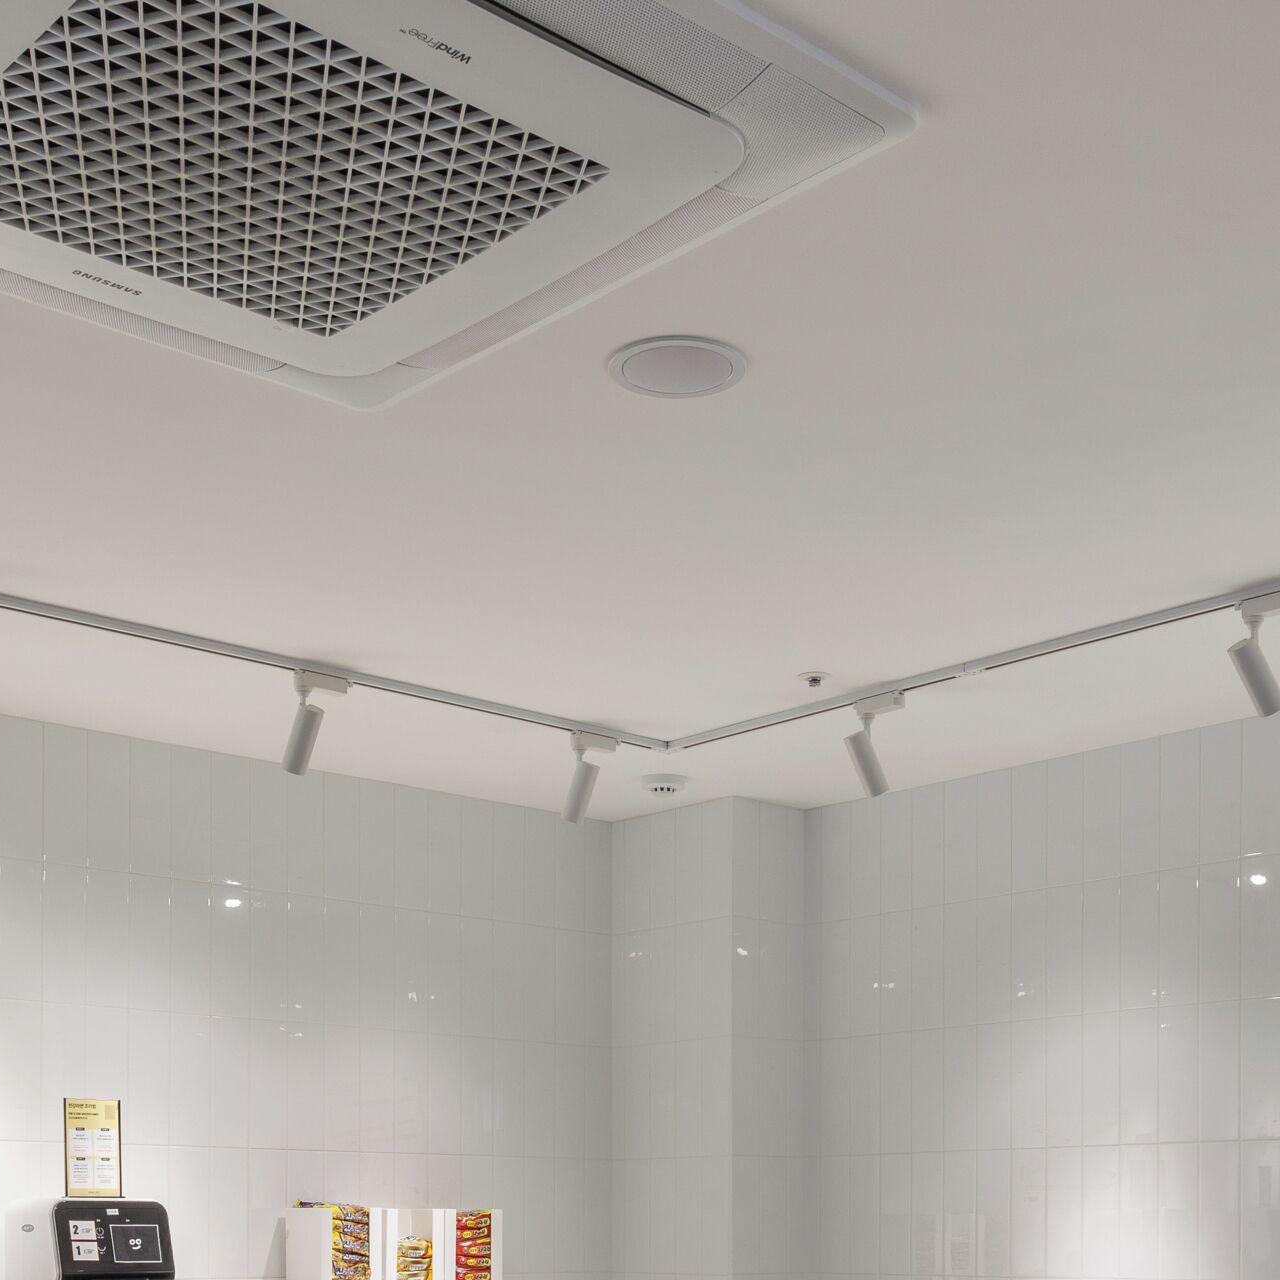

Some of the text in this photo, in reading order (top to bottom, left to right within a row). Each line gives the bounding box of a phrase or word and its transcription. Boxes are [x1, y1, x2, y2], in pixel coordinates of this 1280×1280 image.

[71, 269, 143, 296] SAMSUNG
[73, 1225, 79, 1235] 2
[75, 1245, 81, 1256] 1
